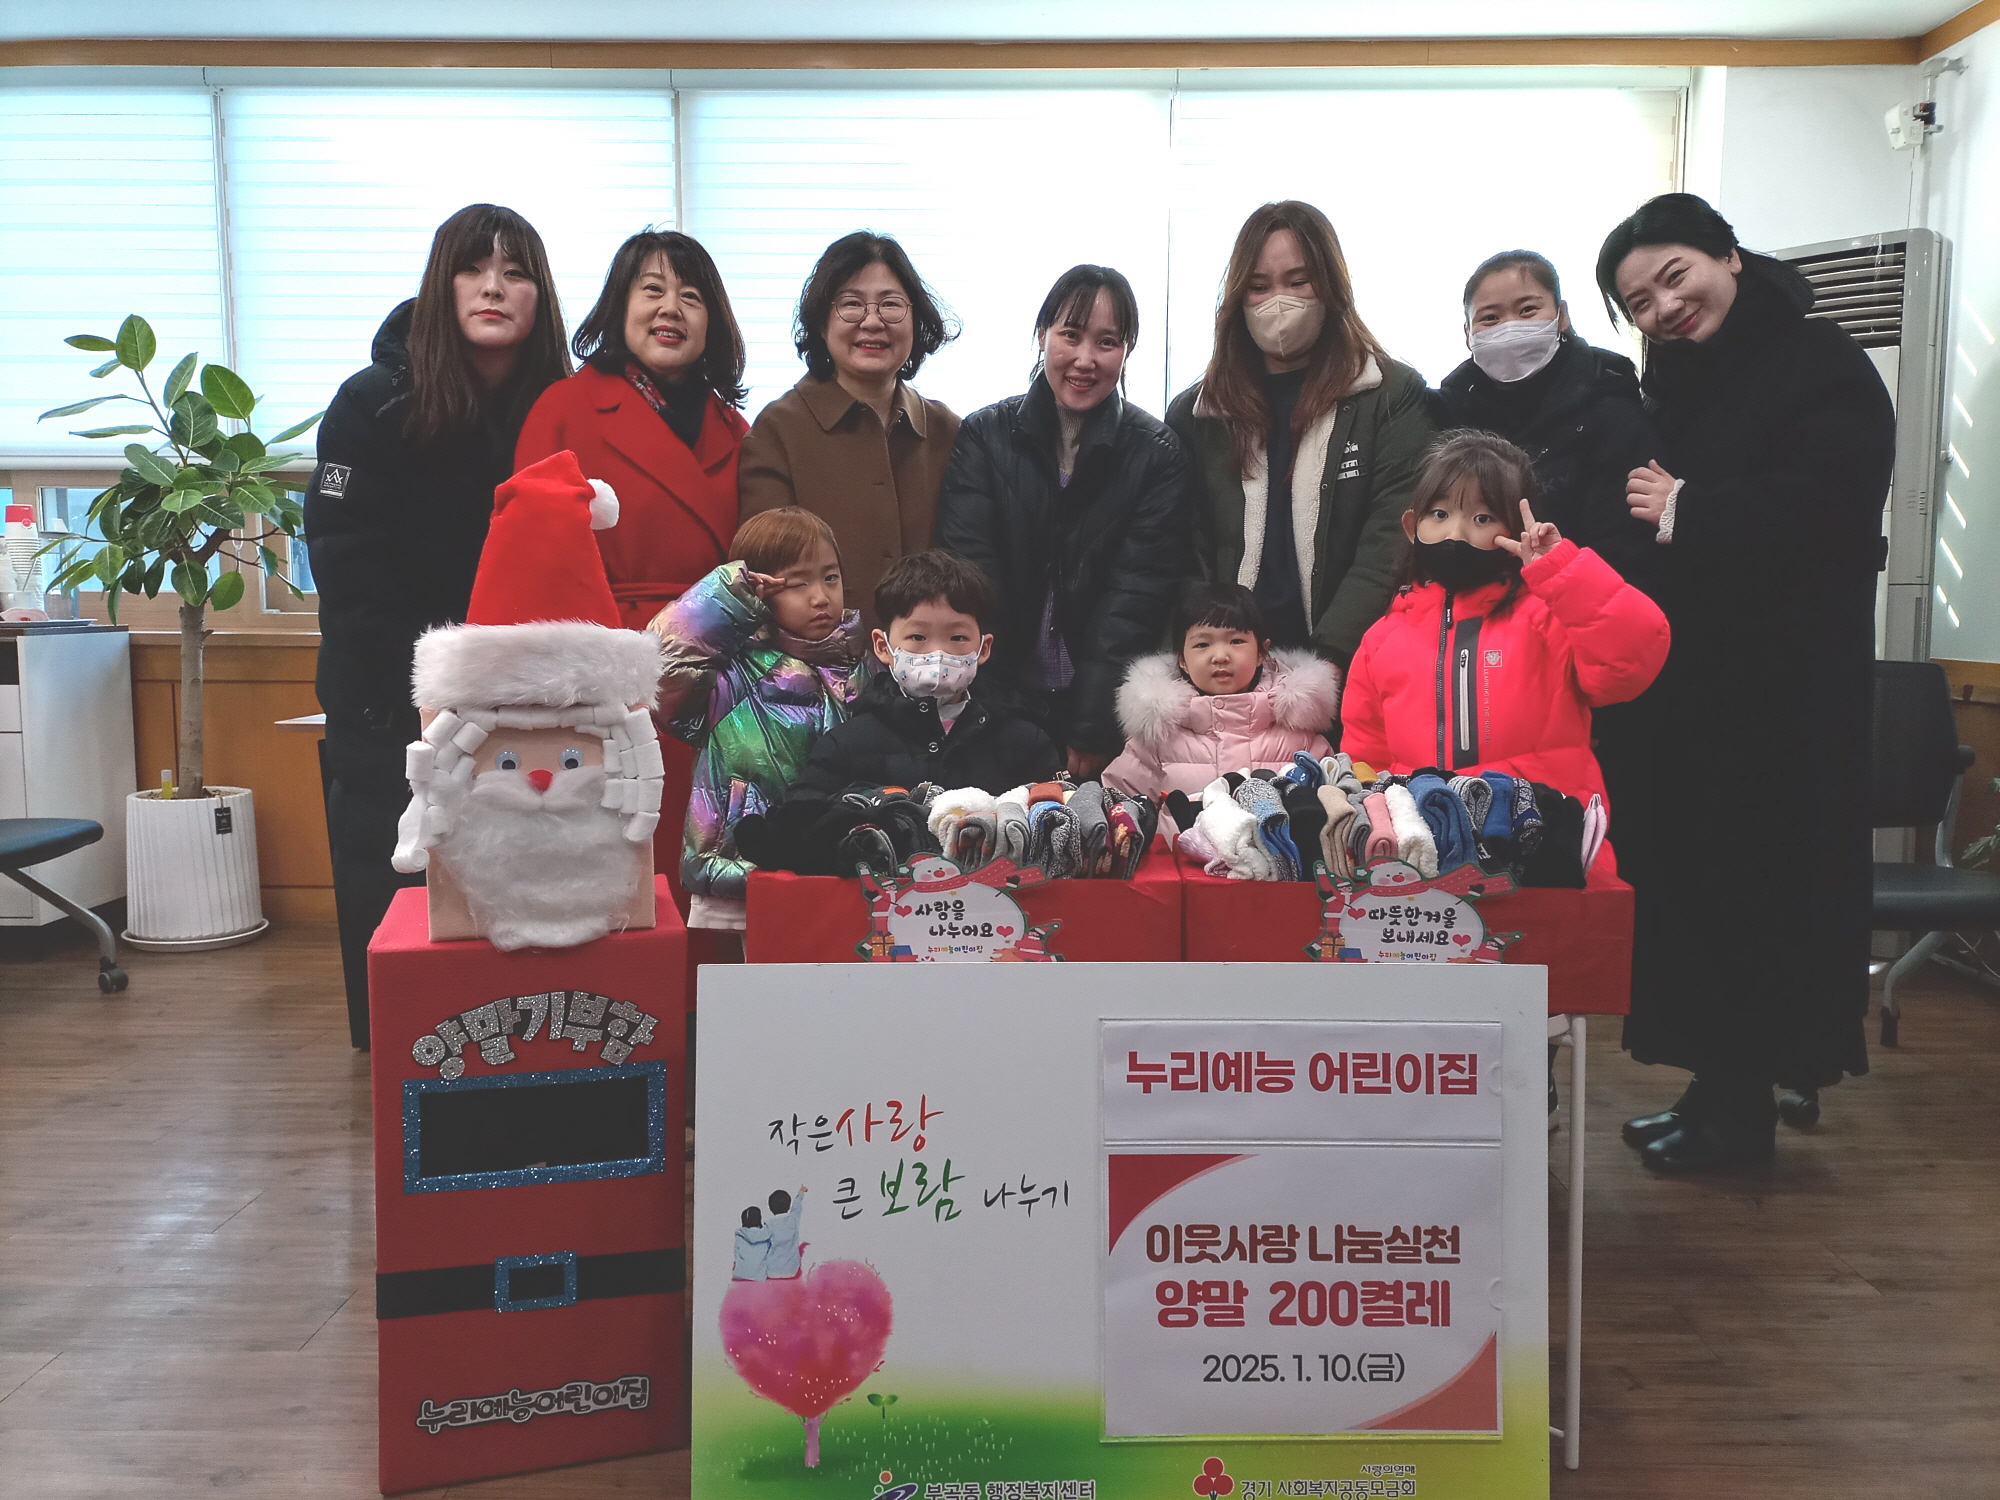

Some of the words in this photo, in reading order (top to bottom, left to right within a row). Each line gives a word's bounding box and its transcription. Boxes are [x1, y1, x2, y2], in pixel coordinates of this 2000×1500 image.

[915, 899, 965, 921] 사랑을
[928, 922, 994, 939] 나누어요
[1380, 928, 1450, 946] 보내세요
[411, 990, 659, 1080] 양말기부함
[1126, 1050, 1296, 1094] 누리예능
[1308, 1051, 1478, 1095] 어린이집
[832, 1177, 863, 1220] 큰
[880, 1157, 966, 1223] 보람
[983, 1173, 1070, 1217] 나누기
[1145, 1224, 1301, 1264] 이웃사랑
[1308, 1224, 1461, 1264] 나눔실천
[1155, 1279, 1249, 1328] 양말
[1268, 1279, 1451, 1328] 200켤레
[416, 1376, 650, 1434] 누리예능어린이집
[1240, 1480, 1271, 1500] 경기
[1276, 1480, 1416, 1500] 사회복지공동모금회
[1360, 1464, 1416, 1477] 사랑의열매
